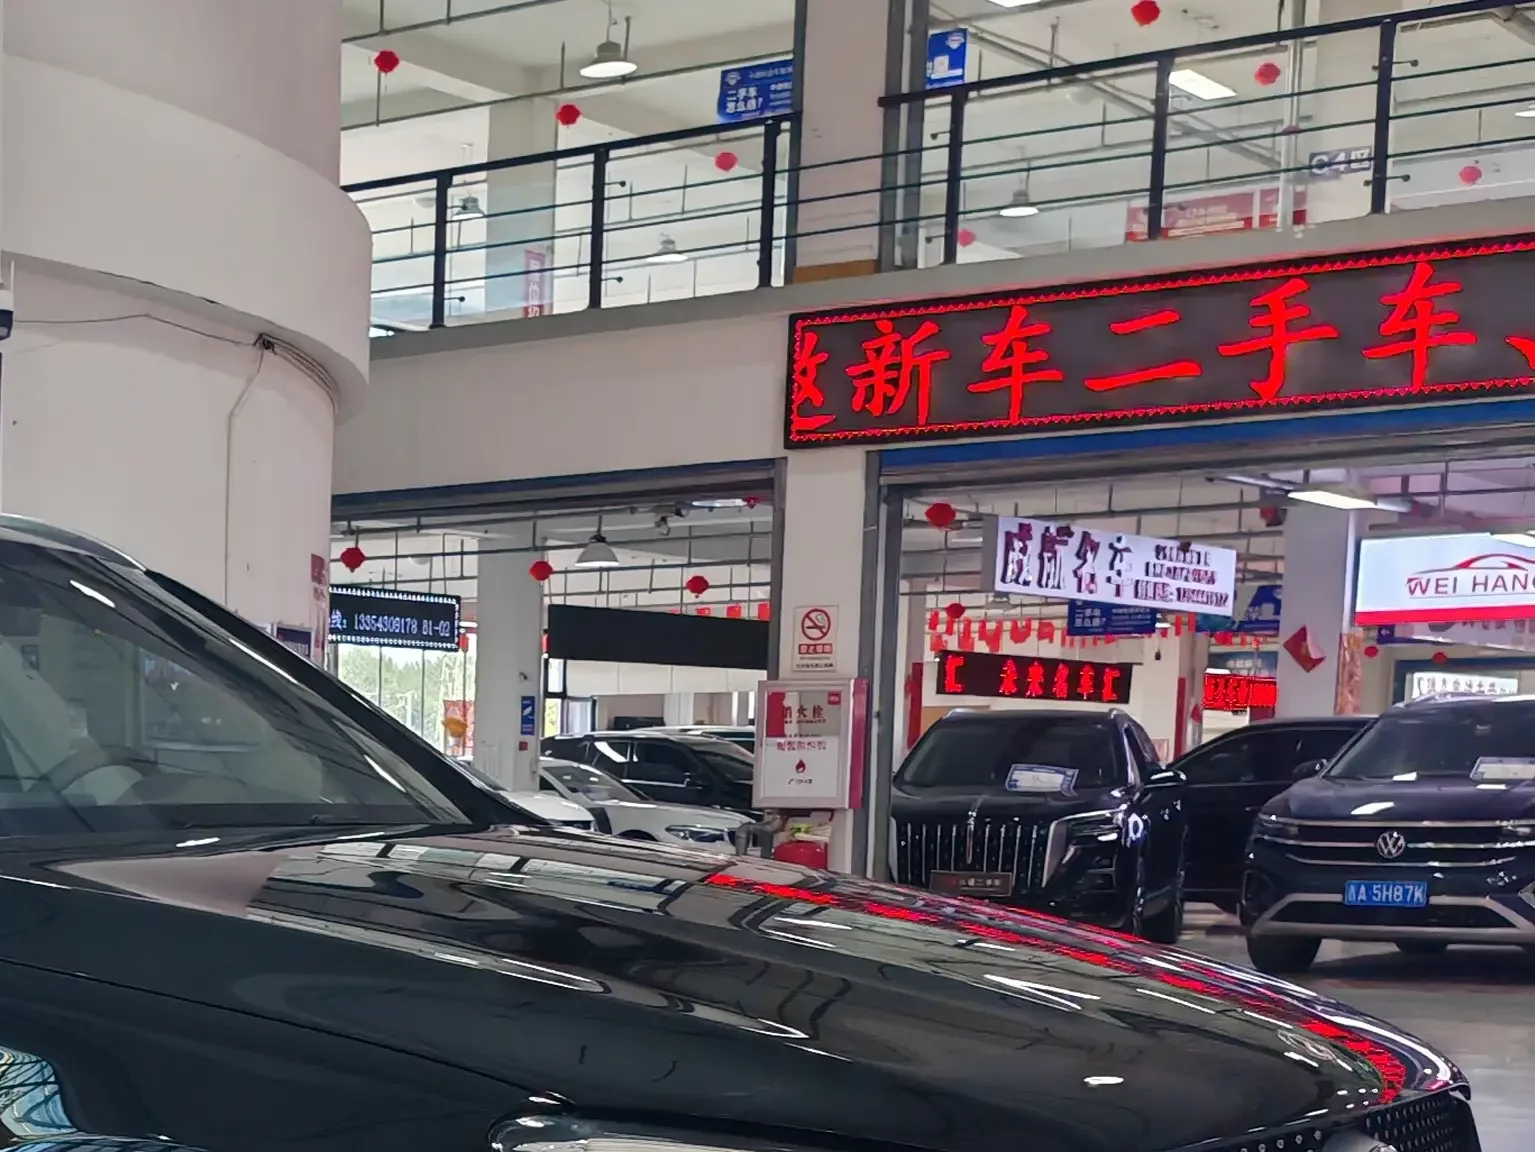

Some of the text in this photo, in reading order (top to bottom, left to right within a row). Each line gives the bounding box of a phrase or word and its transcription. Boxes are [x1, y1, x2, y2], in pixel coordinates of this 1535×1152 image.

[795, 261, 1535, 431] 新车二手车
[1406, 574, 1535, 596] WEI HAN
